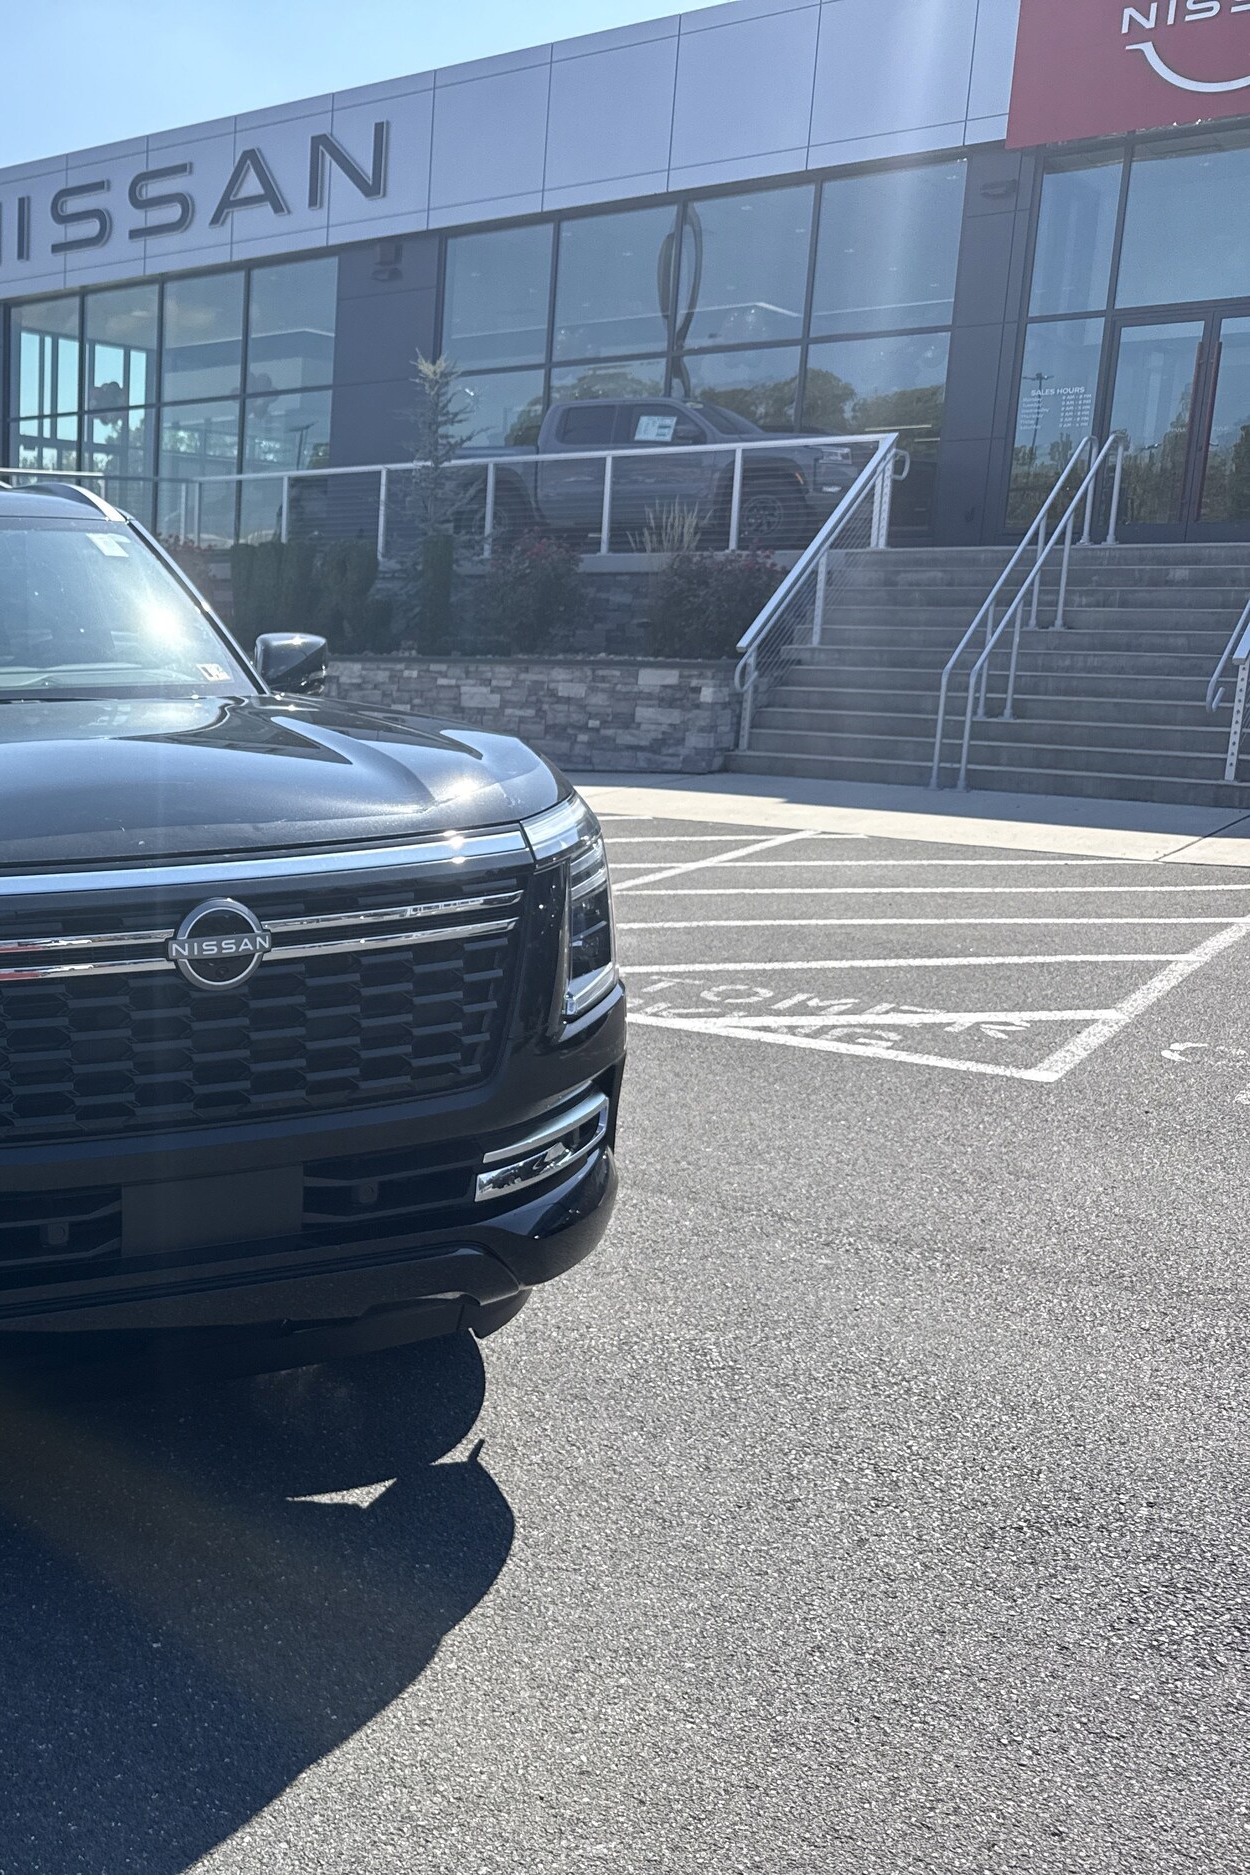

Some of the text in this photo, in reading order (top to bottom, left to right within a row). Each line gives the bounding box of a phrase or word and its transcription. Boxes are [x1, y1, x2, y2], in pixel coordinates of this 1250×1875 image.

[1031, 386, 1085, 396] SALES HOURS
[171, 935, 270, 957] NISSAN
